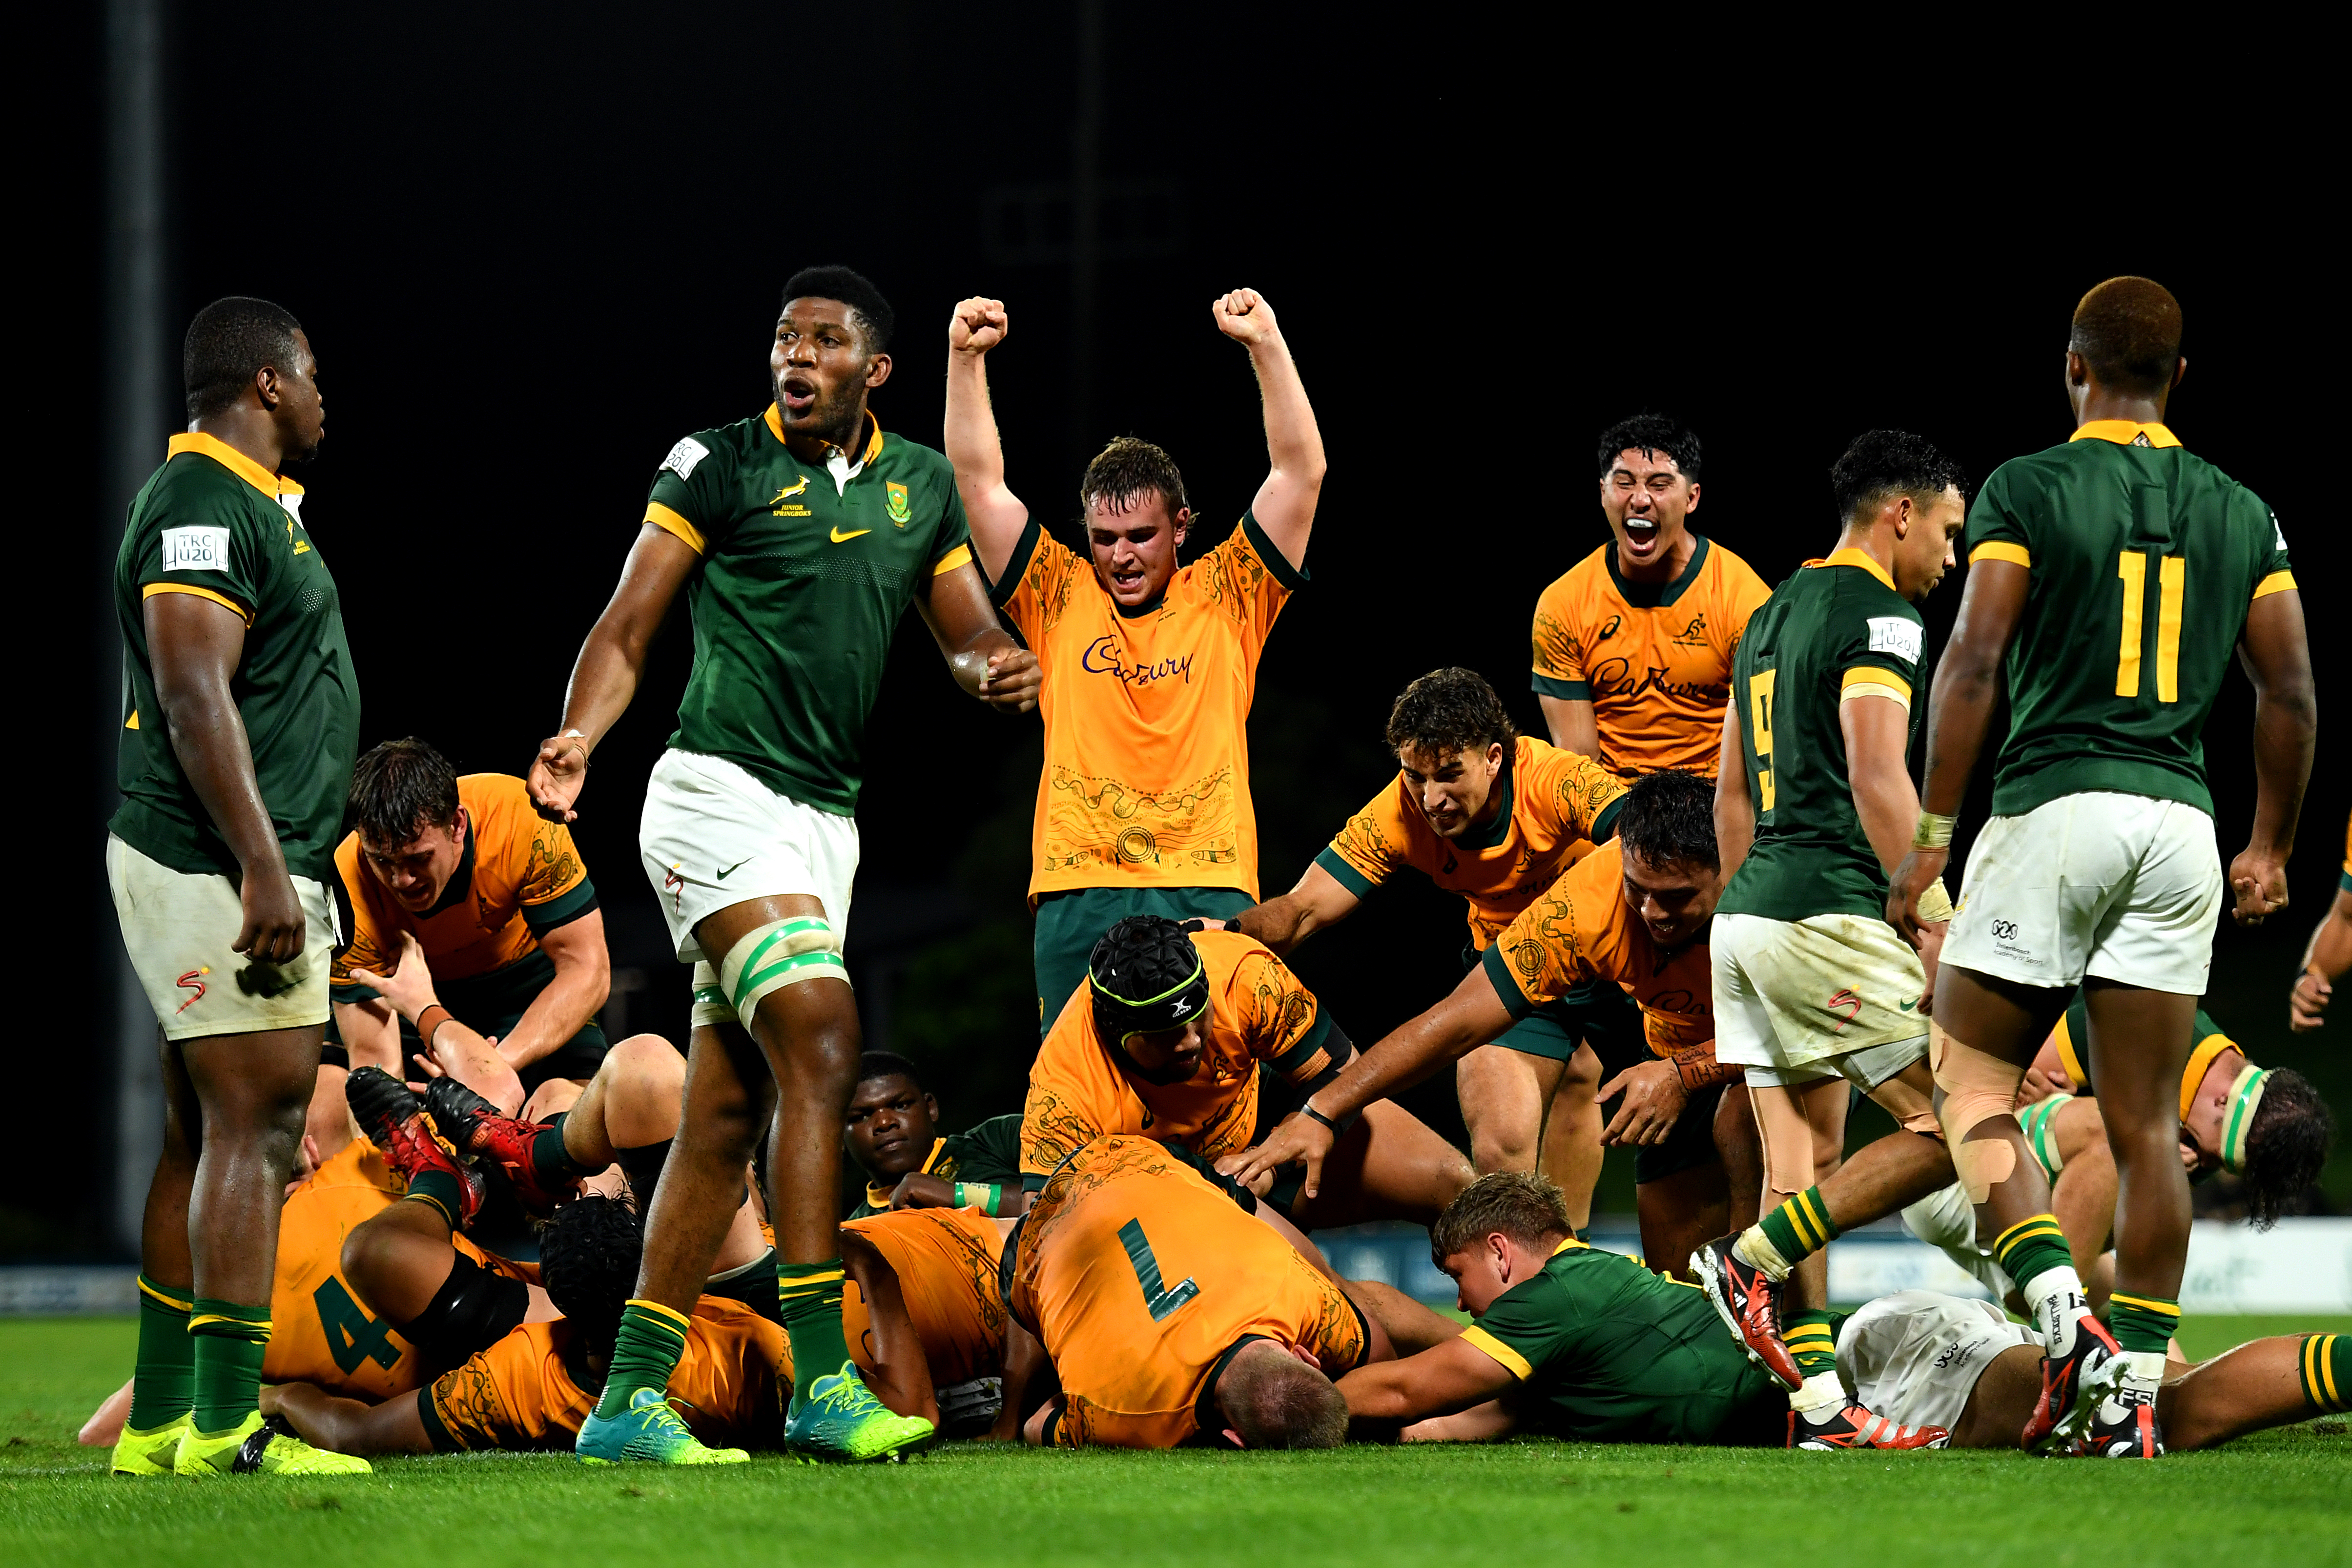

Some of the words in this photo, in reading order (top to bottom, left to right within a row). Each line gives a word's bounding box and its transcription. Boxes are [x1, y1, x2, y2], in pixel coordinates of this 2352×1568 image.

[666, 453, 682, 468] 20
[179, 535, 211, 547] TRC
[179, 549, 212, 561] U20
[2115, 551, 2185, 702] 11
[1886, 634, 1911, 651] U20
[1750, 669, 1776, 811] 9
[1172, 1005, 1191, 1018] GILBERT
[1117, 1217, 1200, 1322] 7
[313, 1275, 402, 1376] 4
